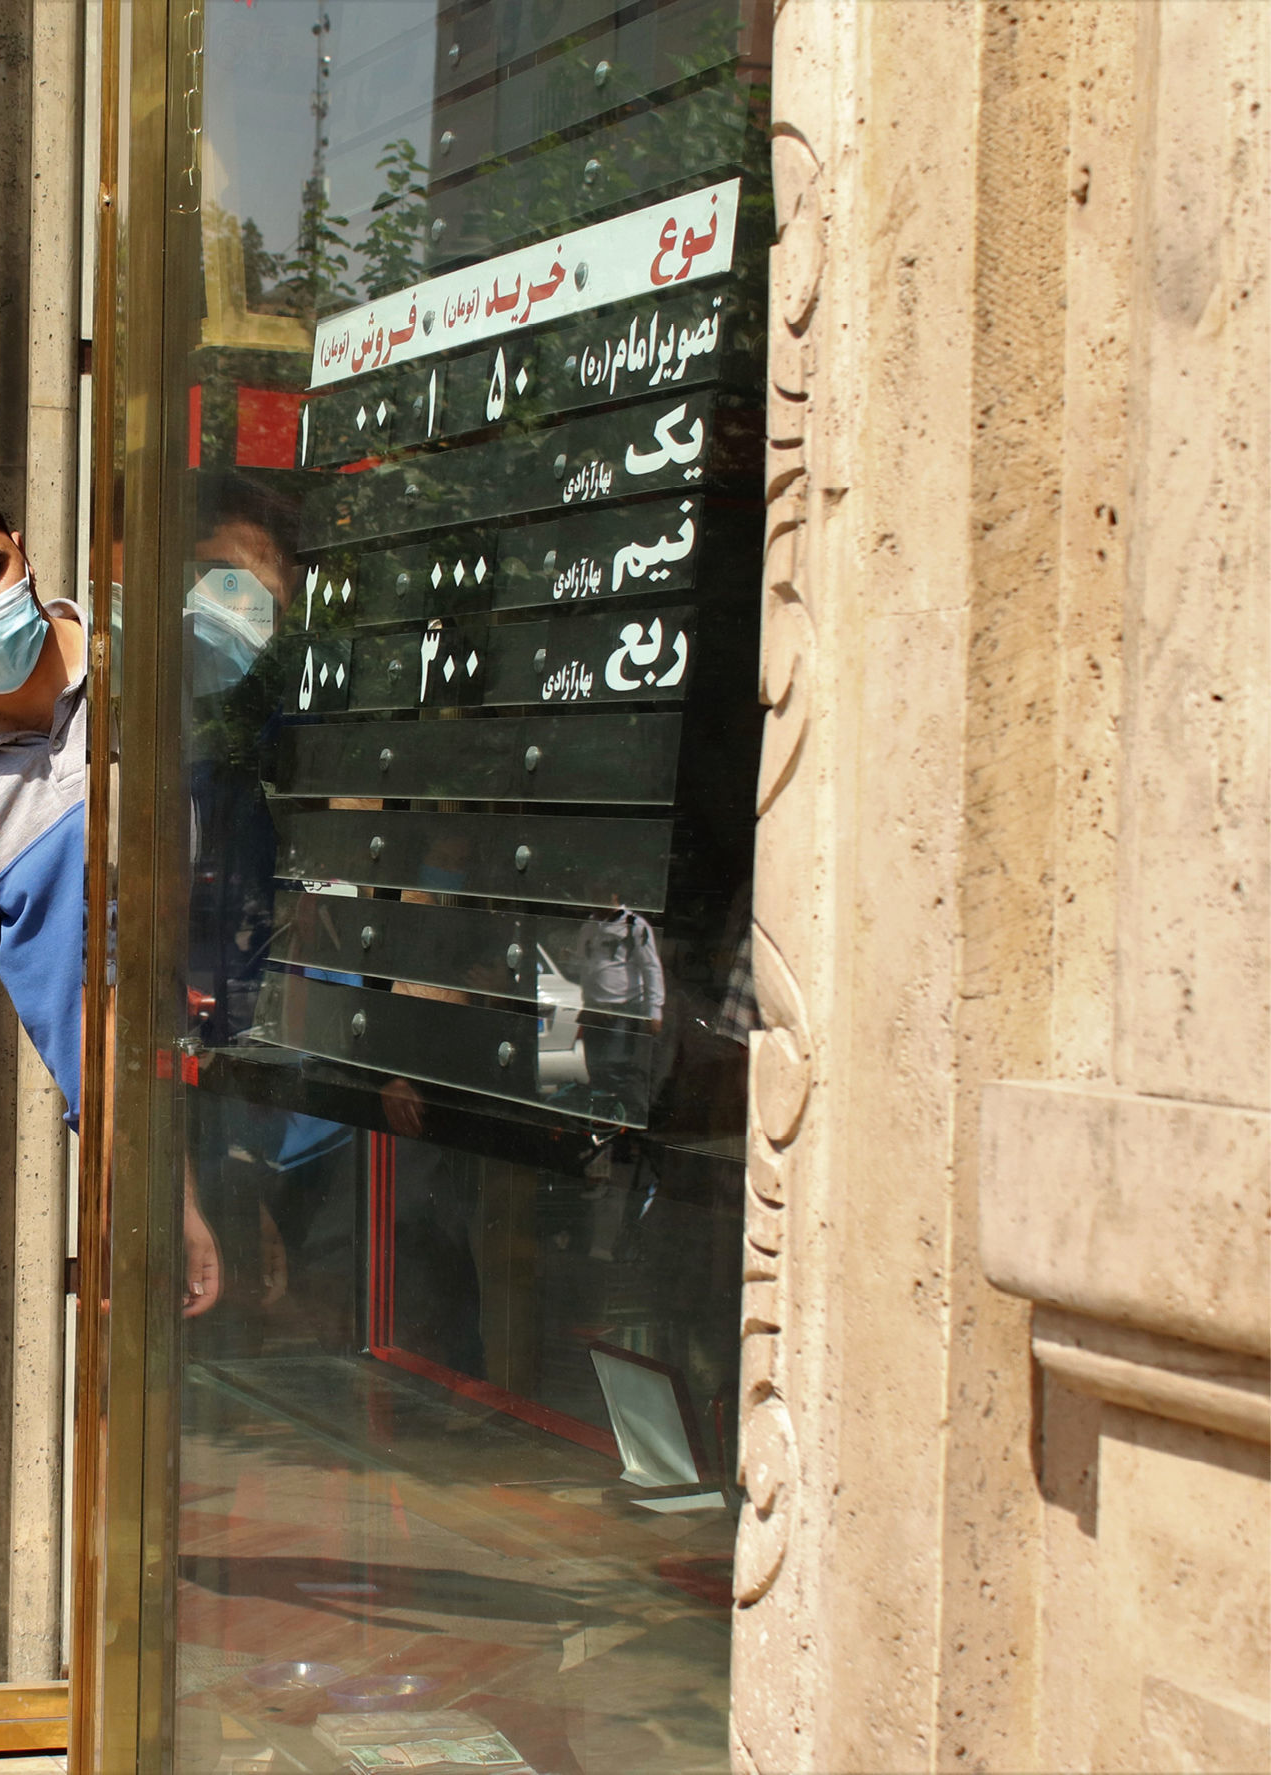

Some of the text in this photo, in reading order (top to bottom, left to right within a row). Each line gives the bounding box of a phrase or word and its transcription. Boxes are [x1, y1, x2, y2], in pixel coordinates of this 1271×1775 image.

[320, 193, 719, 374] نوع خرید (تومان) فروش (تومان)
[624, 402, 705, 482] یک
[611, 499, 696, 592] نیم
[604, 616, 690, 692] ربع
